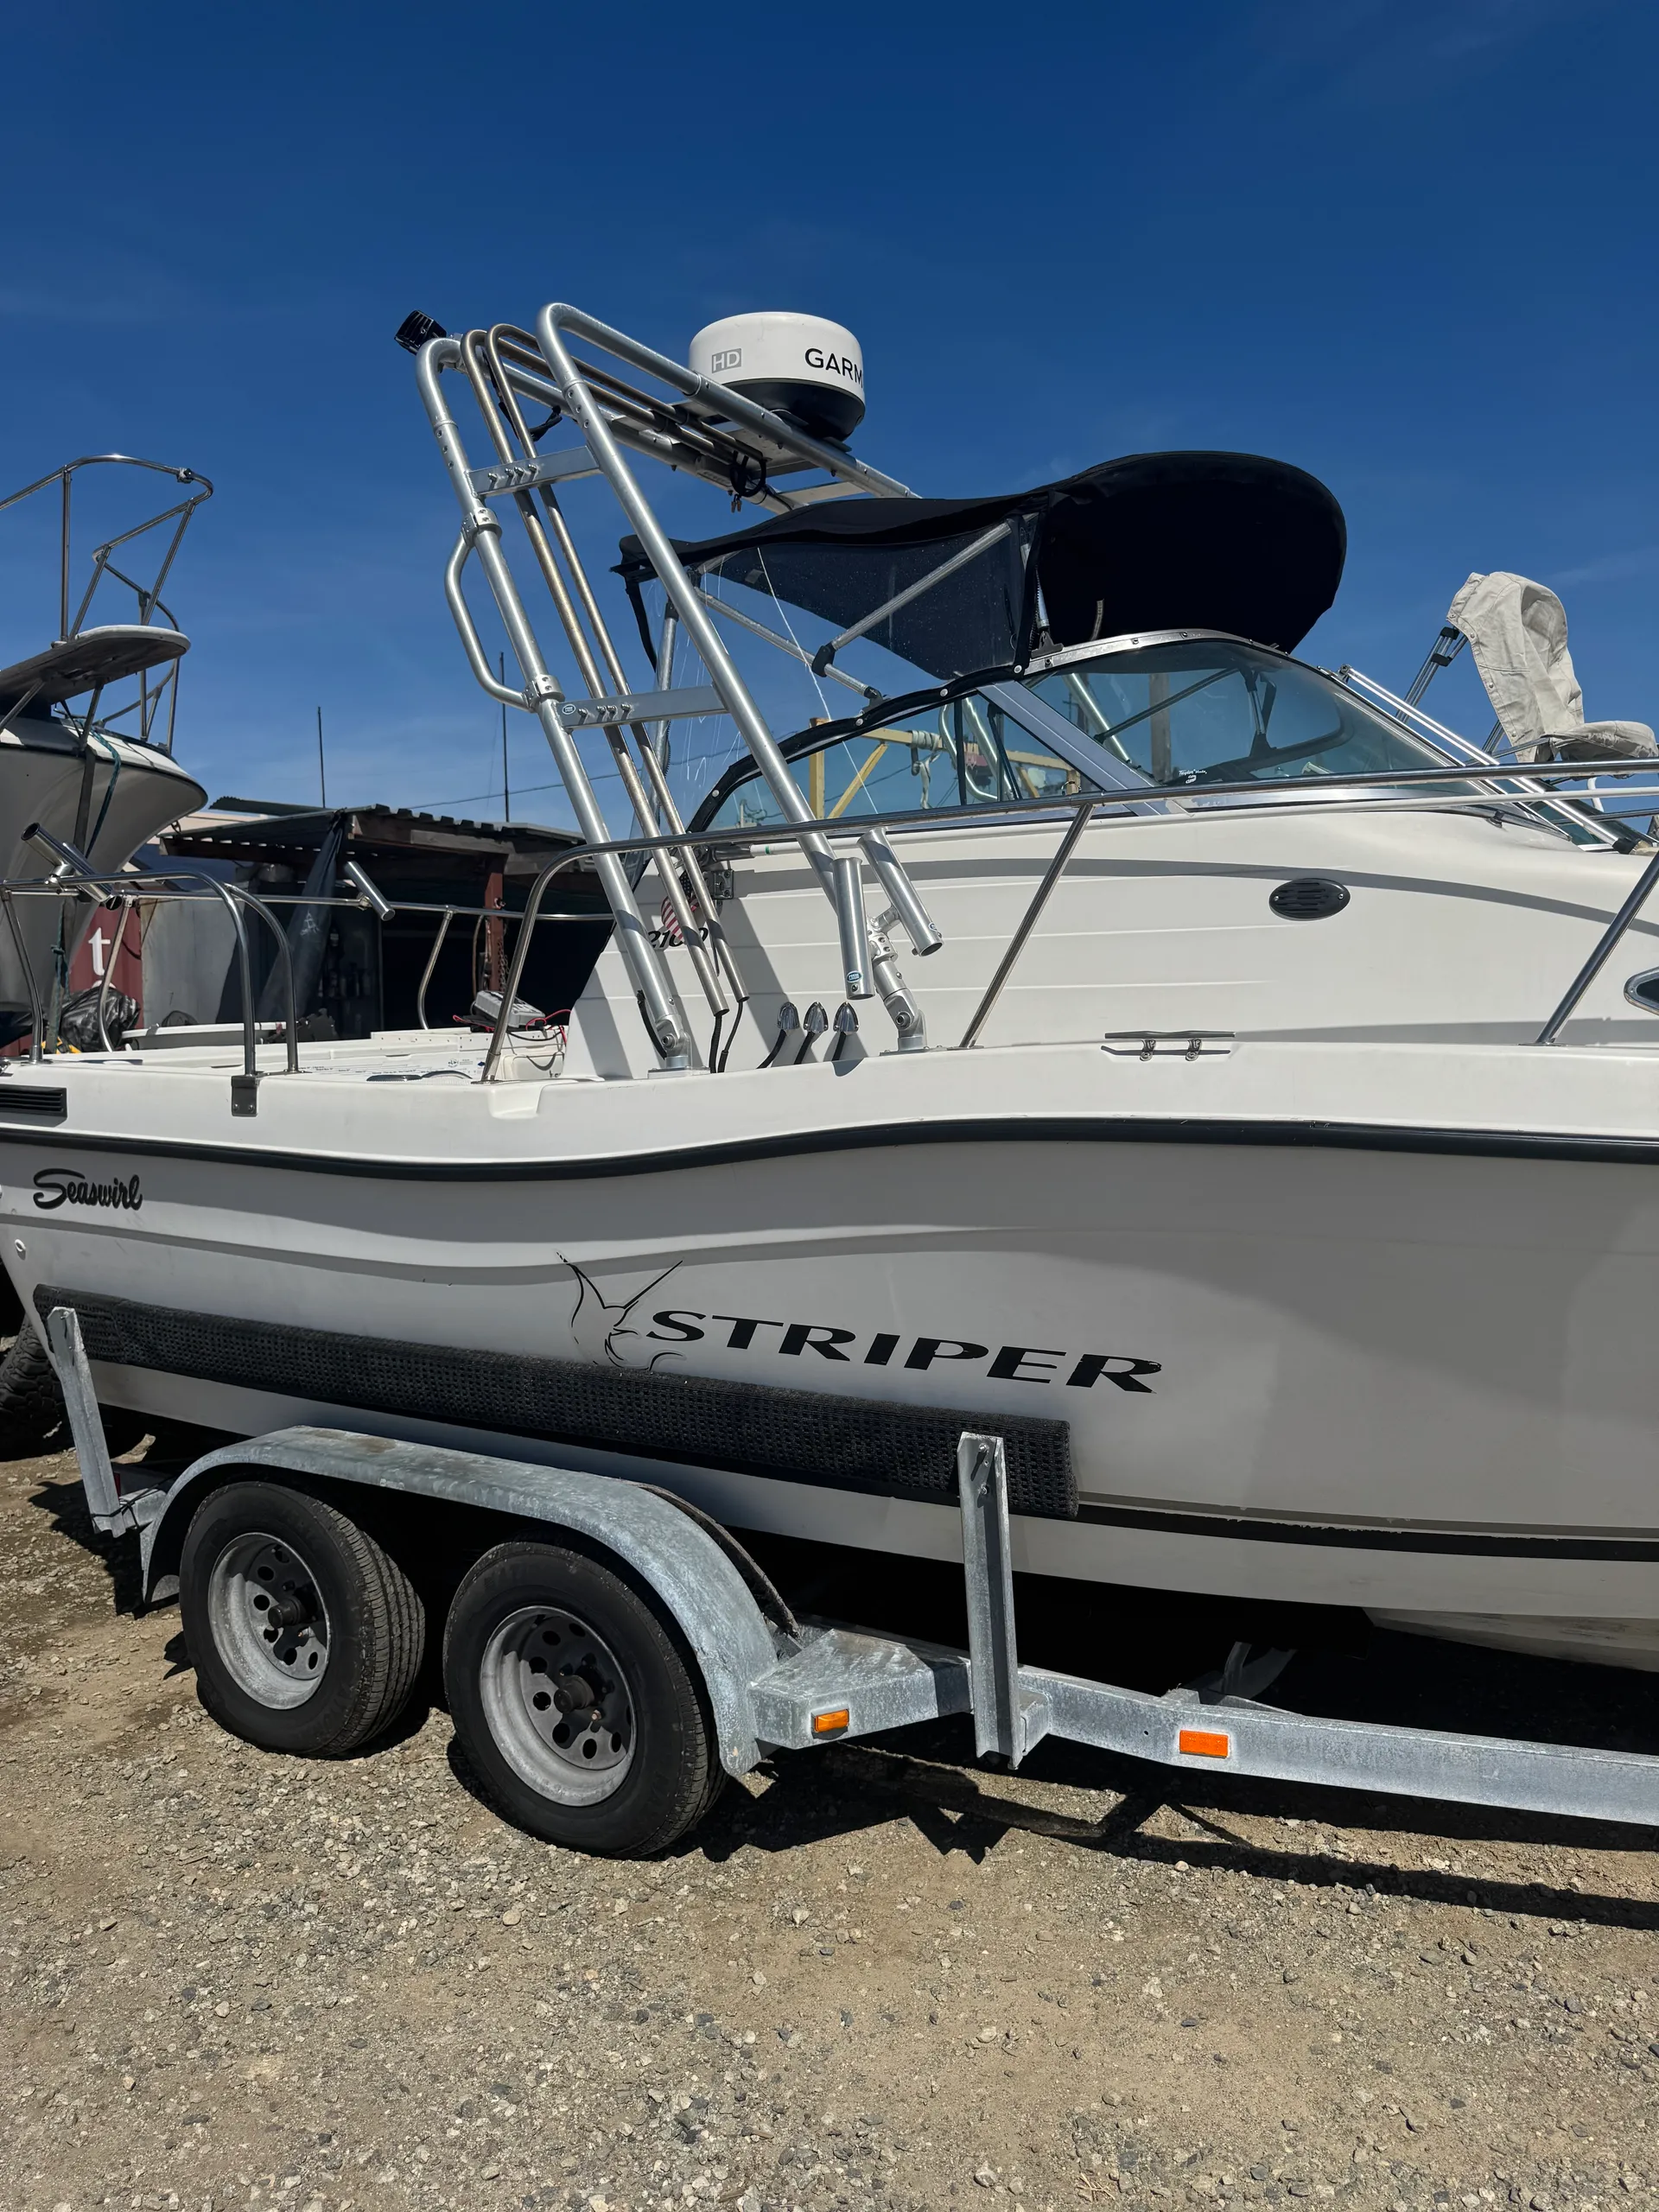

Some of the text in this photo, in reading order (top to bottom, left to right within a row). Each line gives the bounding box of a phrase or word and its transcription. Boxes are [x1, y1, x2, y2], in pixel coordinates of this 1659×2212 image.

[712, 350, 741, 372] HD
[804, 347, 863, 389] GARM
[33, 1167, 143, 1211] Seaswirl
[645, 1309, 1162, 1395] STRIPER
